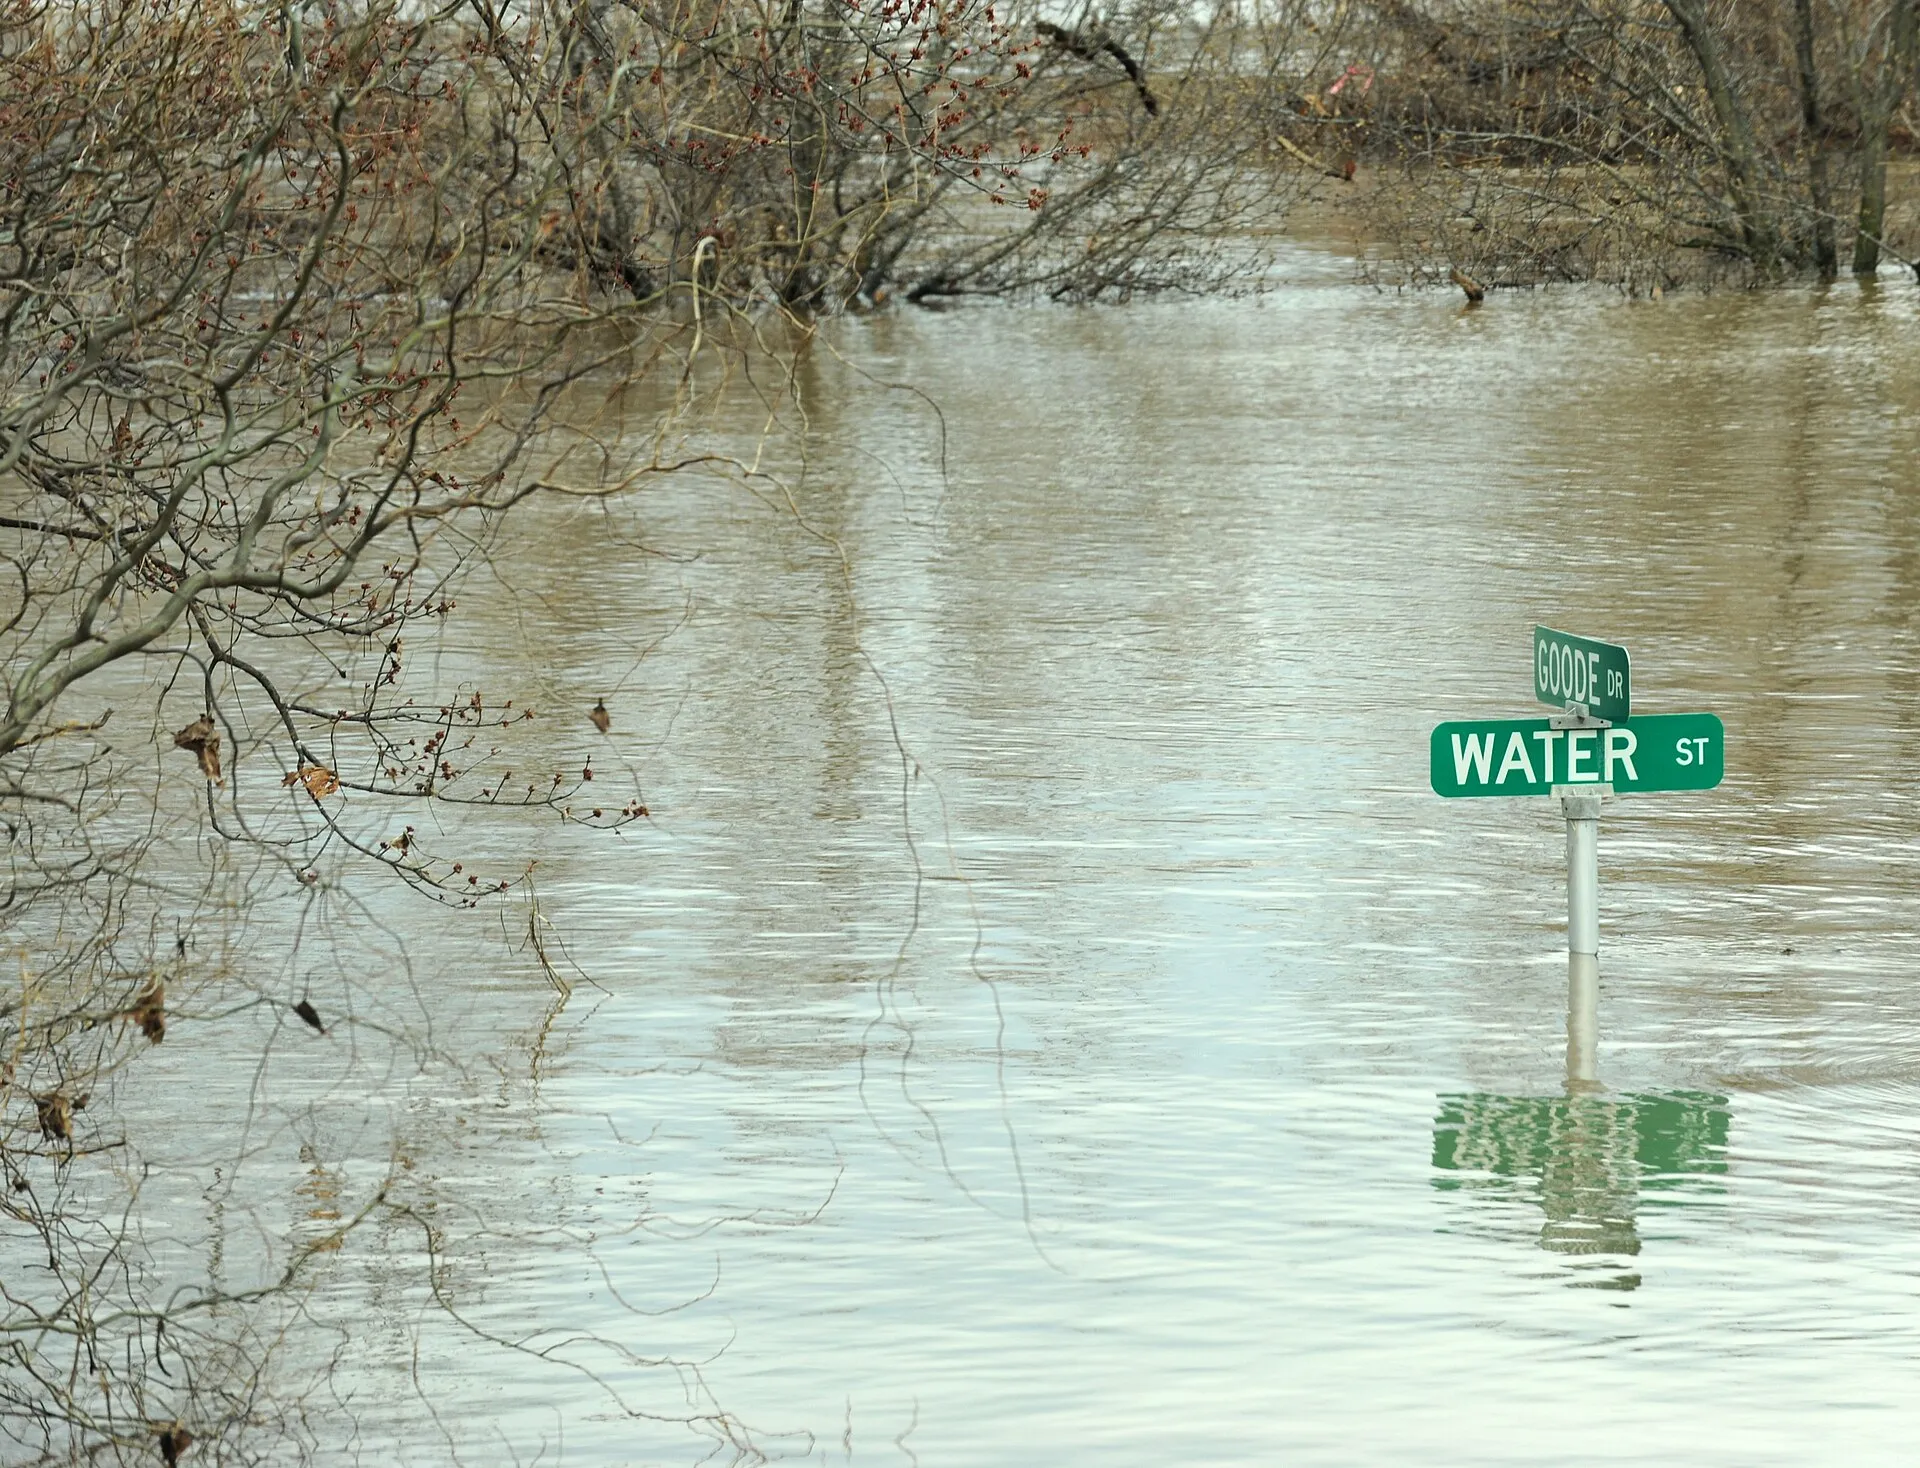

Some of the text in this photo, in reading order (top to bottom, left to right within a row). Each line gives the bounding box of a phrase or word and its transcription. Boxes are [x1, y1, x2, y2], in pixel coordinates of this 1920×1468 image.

[1538, 638, 1624, 706] GOODE DR
[1451, 728, 1710, 785] WATER ST
